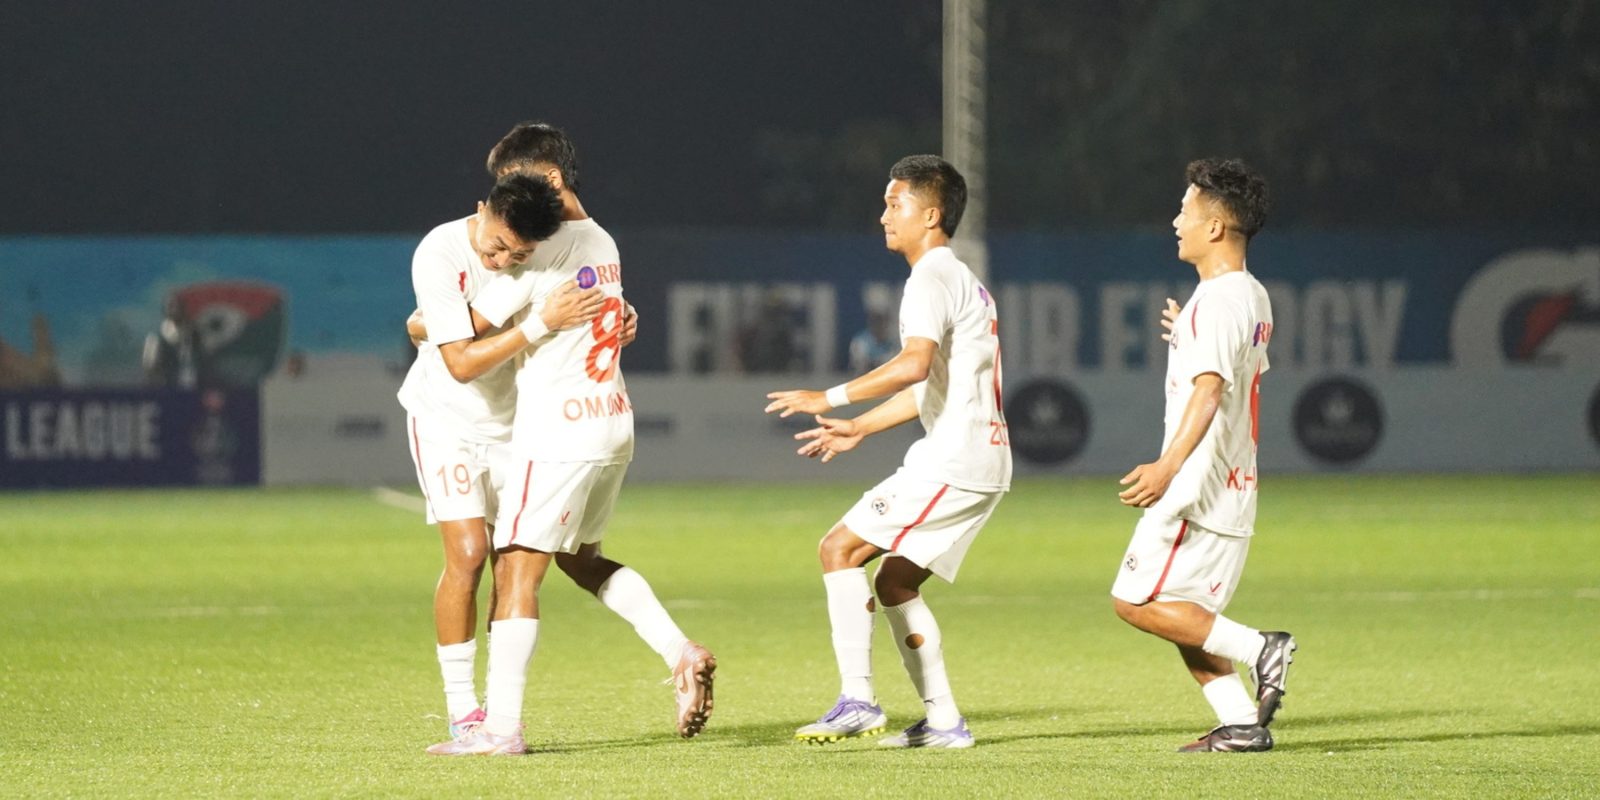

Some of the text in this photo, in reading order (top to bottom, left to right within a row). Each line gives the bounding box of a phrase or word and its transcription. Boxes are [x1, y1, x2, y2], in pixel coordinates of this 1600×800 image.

[585, 297, 623, 383] 8
[5, 402, 161, 460] LEAGUE
[436, 463, 471, 497] 19
